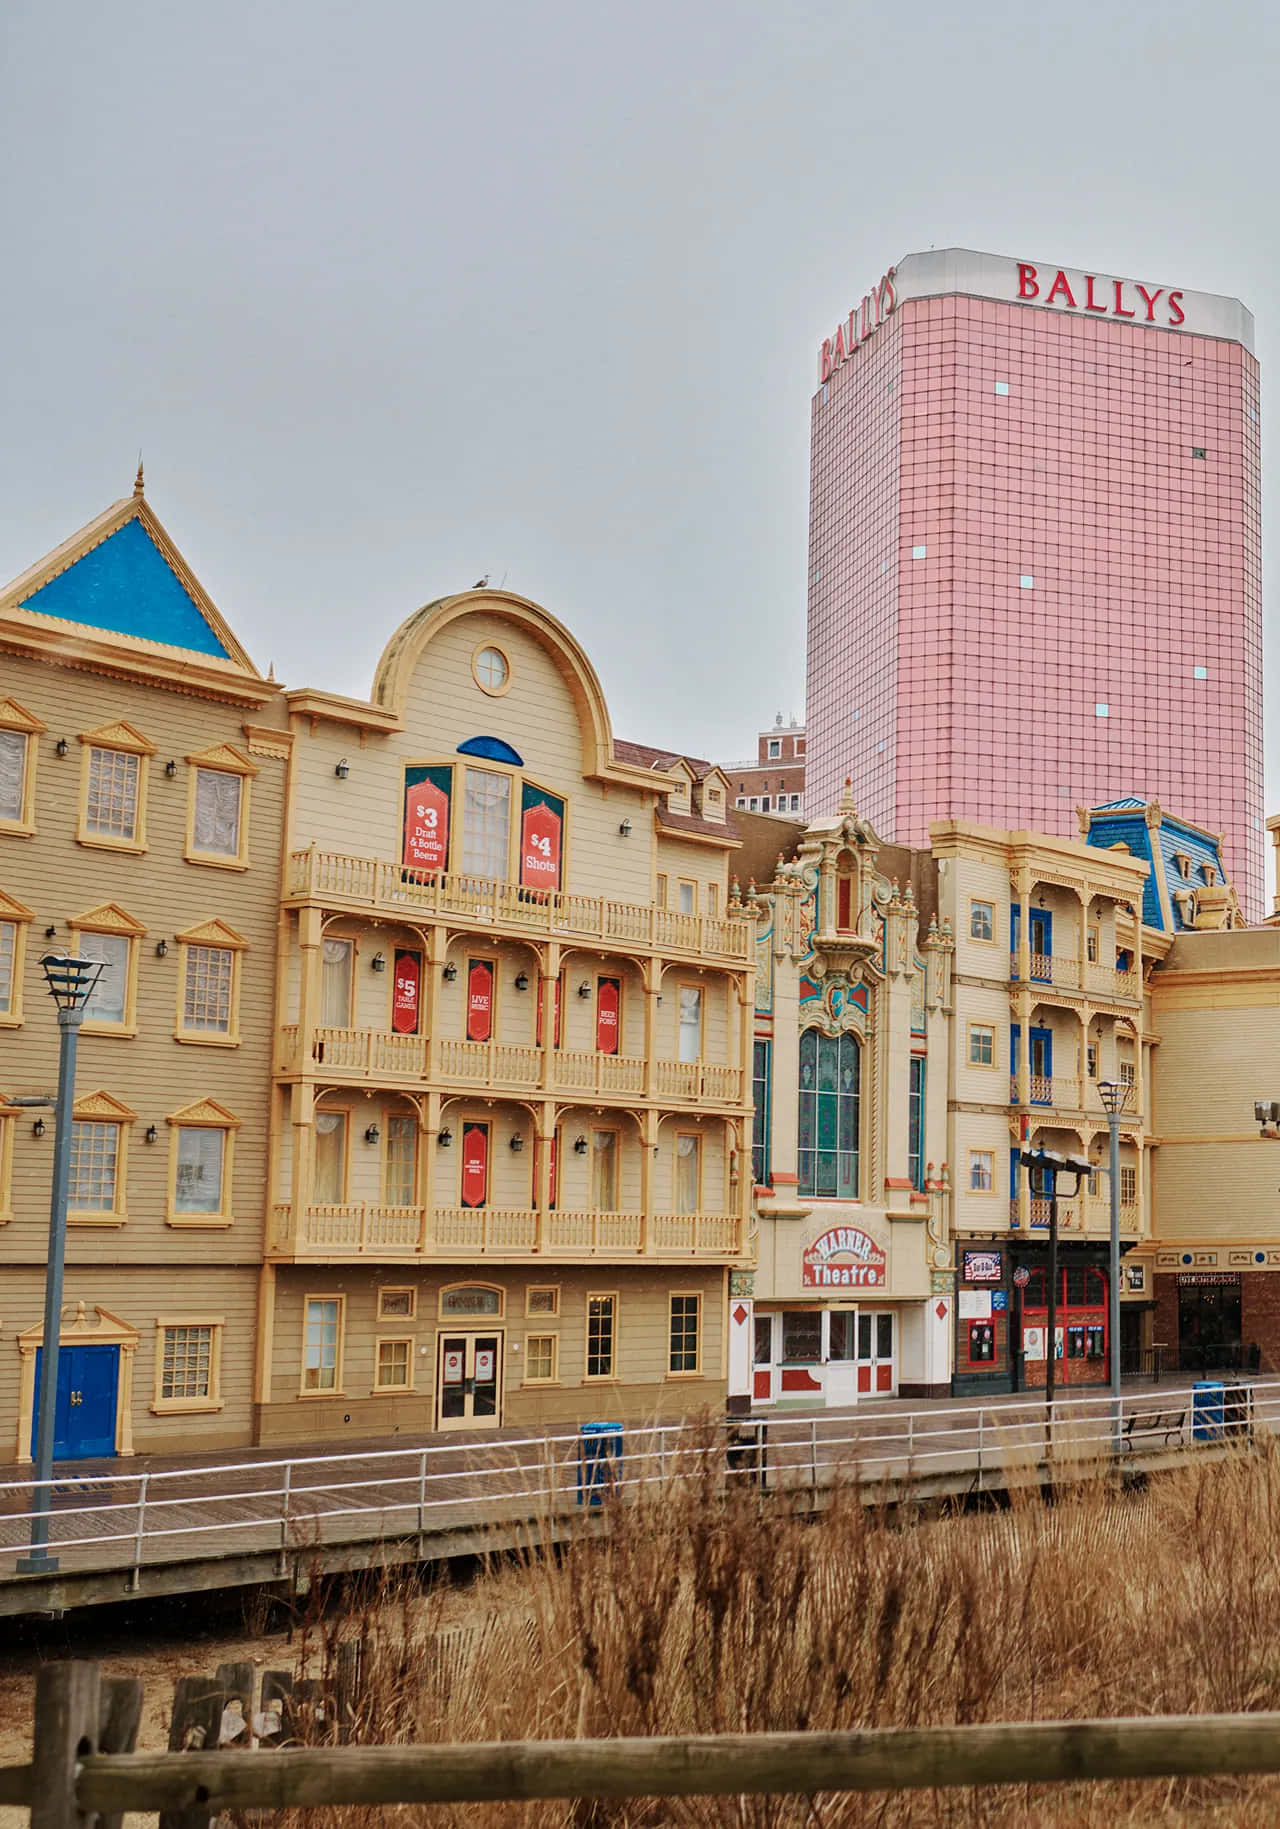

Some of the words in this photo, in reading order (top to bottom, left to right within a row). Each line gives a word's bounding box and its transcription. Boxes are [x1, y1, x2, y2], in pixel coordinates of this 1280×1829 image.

[1016, 263, 1185, 325] BALLYS
[416, 804, 438, 828] $3
[415, 826, 437, 839] Draft
[410, 838, 418, 847] &
[418, 838, 443, 851] Bottle
[531, 833, 551, 857] $4
[413, 848, 438, 861] Beers
[526, 855, 556, 873] Shots
[397, 978, 416, 997] $5
[471, 995, 489, 1005] LIVE
[815, 1229, 872, 1262] WARNER
[812, 1264, 877, 1285] Theatre
